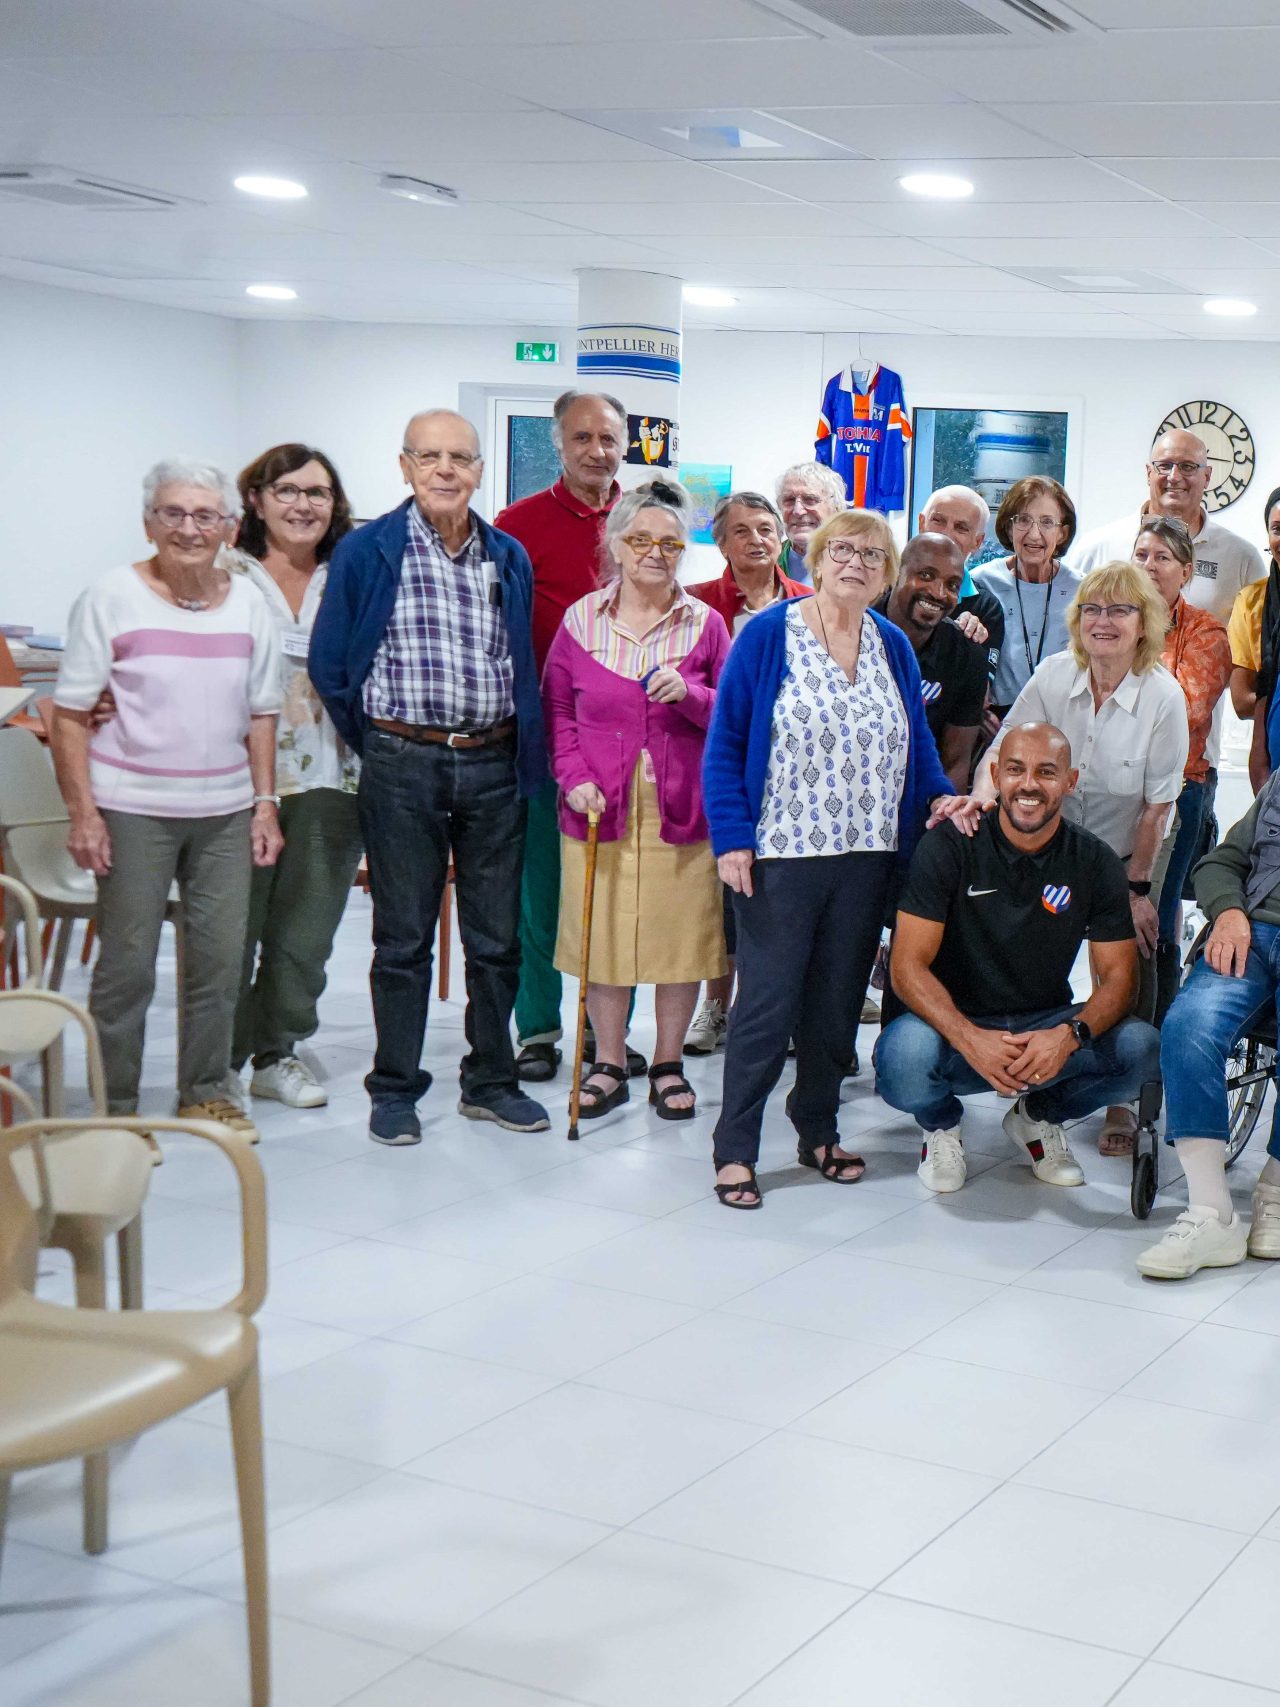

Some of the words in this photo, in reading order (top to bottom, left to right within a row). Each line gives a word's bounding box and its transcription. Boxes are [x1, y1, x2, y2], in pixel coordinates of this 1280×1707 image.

[577, 338, 656, 353] NTPELLIER
[1199, 401, 1218, 424] 12
[1229, 427, 1251, 447] 2
[1233, 450, 1254, 465] 3
[1229, 475, 1247, 491] 4
[1213, 486, 1231, 508] 5
